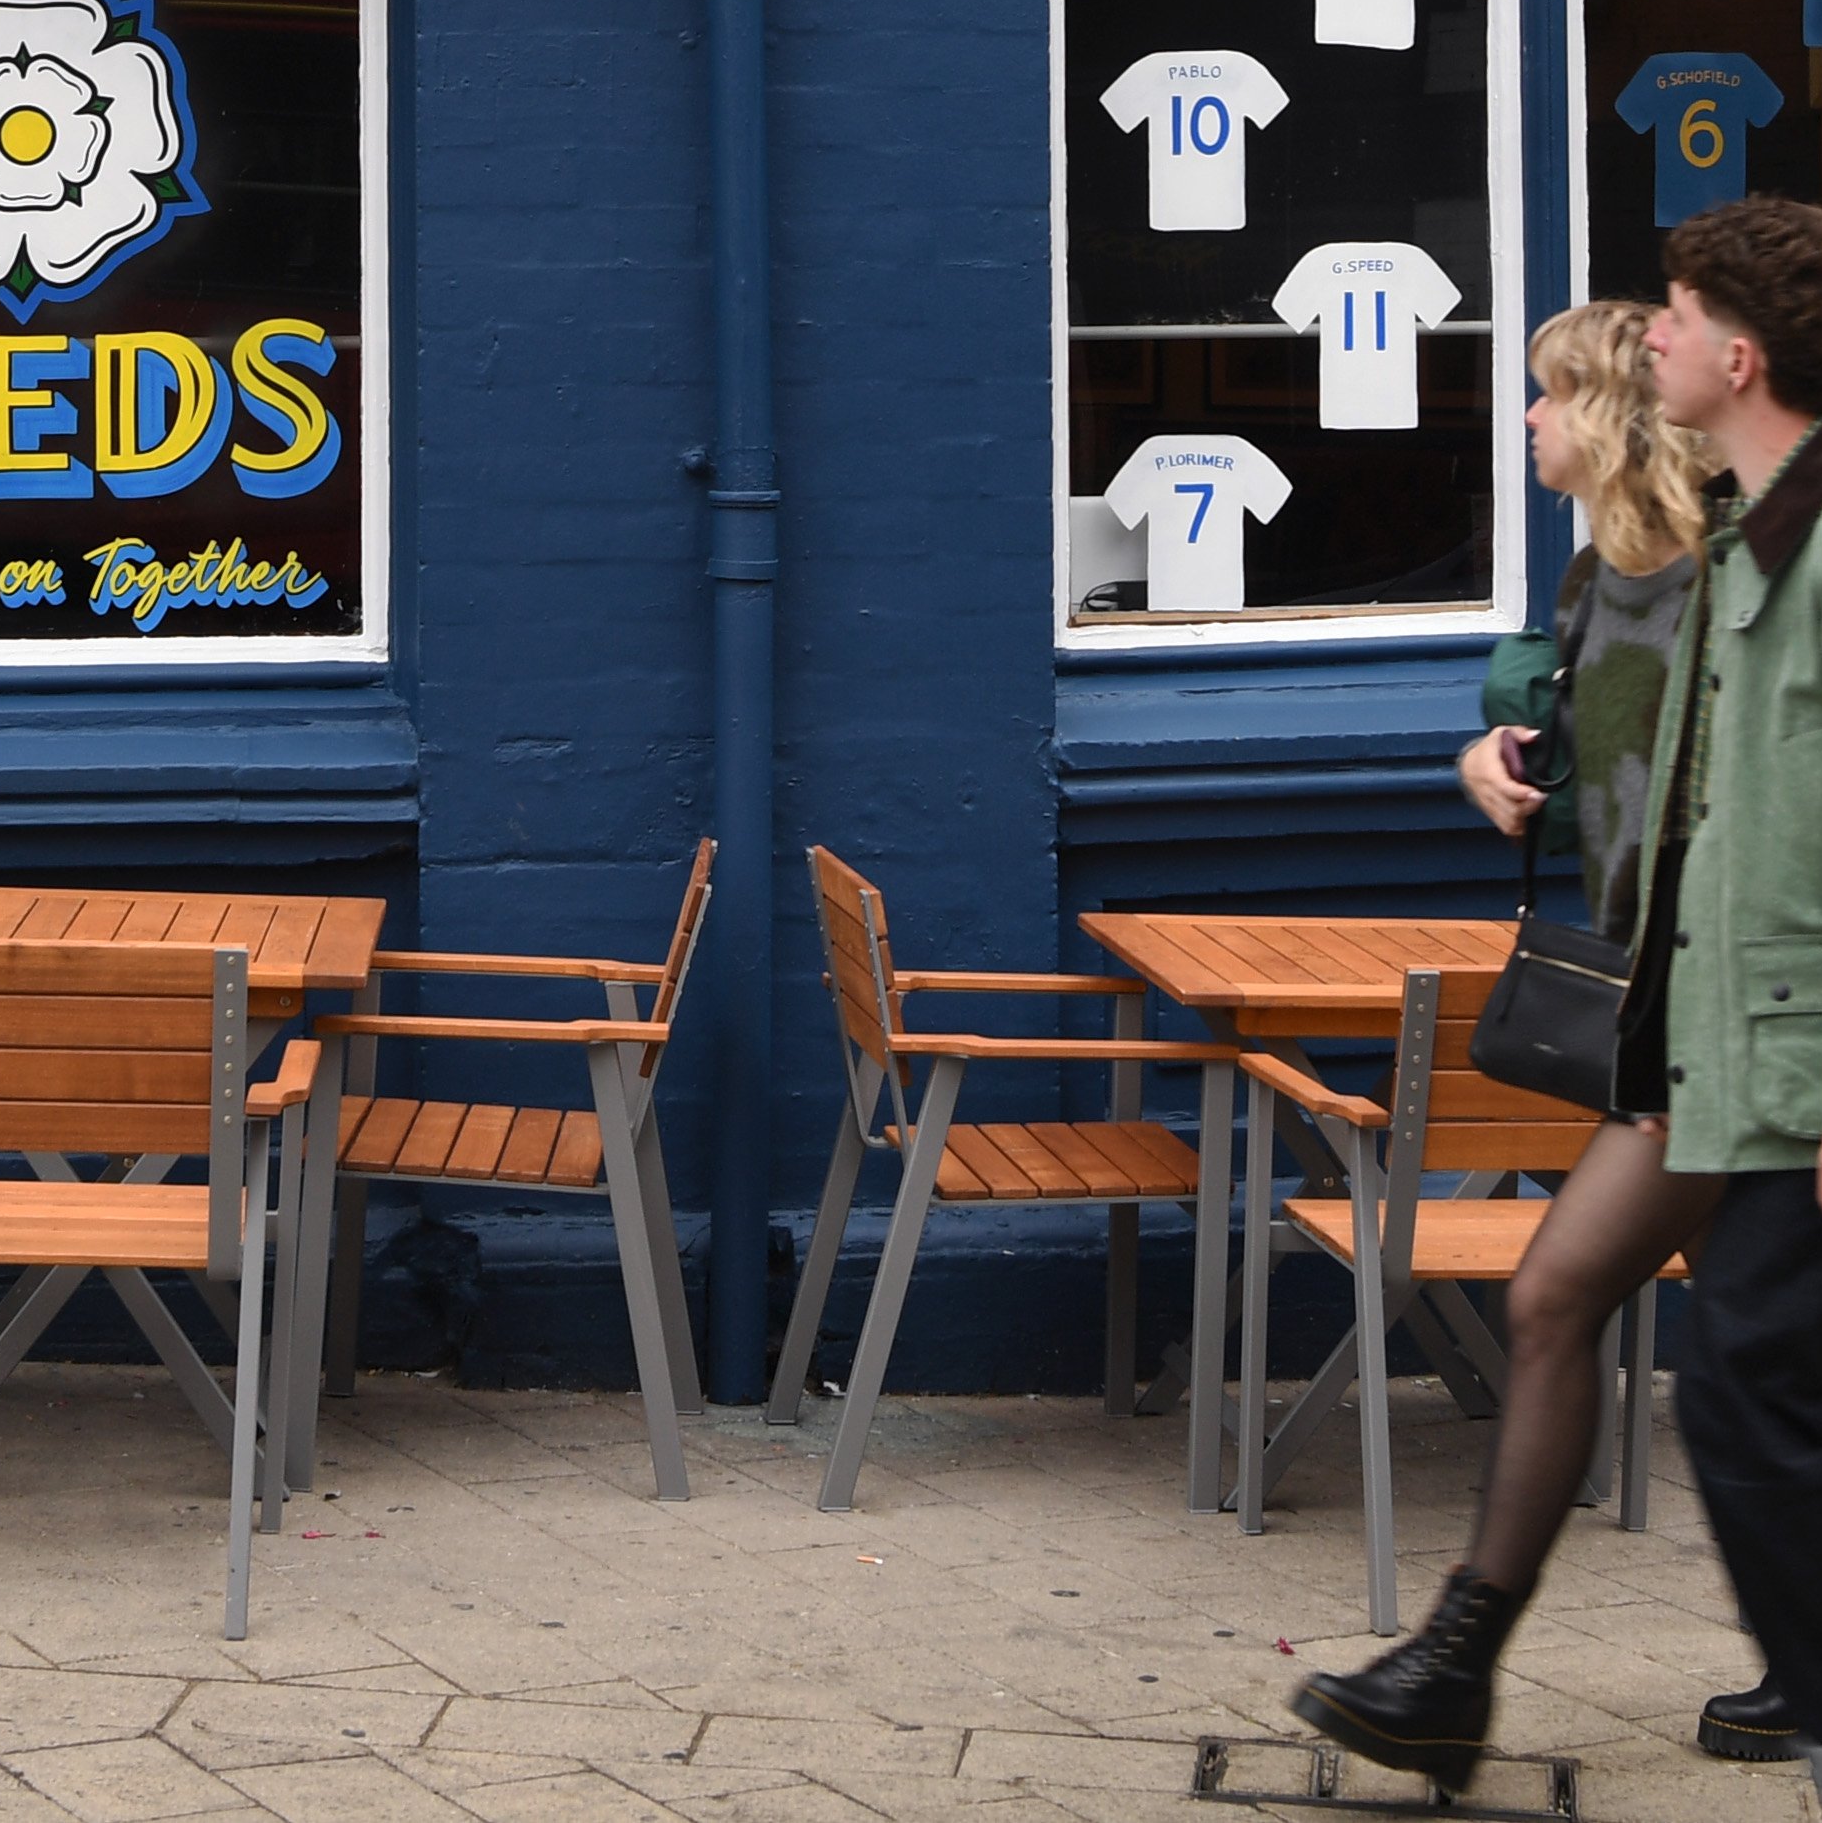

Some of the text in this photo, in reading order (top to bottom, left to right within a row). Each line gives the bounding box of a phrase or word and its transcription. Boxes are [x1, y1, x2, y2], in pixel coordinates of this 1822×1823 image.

[1169, 65, 1222, 80] PABLO
[1657, 70, 1740, 89] G.SCHOFIELD
[1172, 94, 1231, 156] 10
[1679, 99, 1725, 167] 6
[1332, 260, 1393, 274] G.SPEED
[1344, 291, 1386, 352] 11
[1155, 453, 1234, 471] P.LORIMER
[1174, 483, 1214, 544] 7
[83, 537, 329, 632] Together
